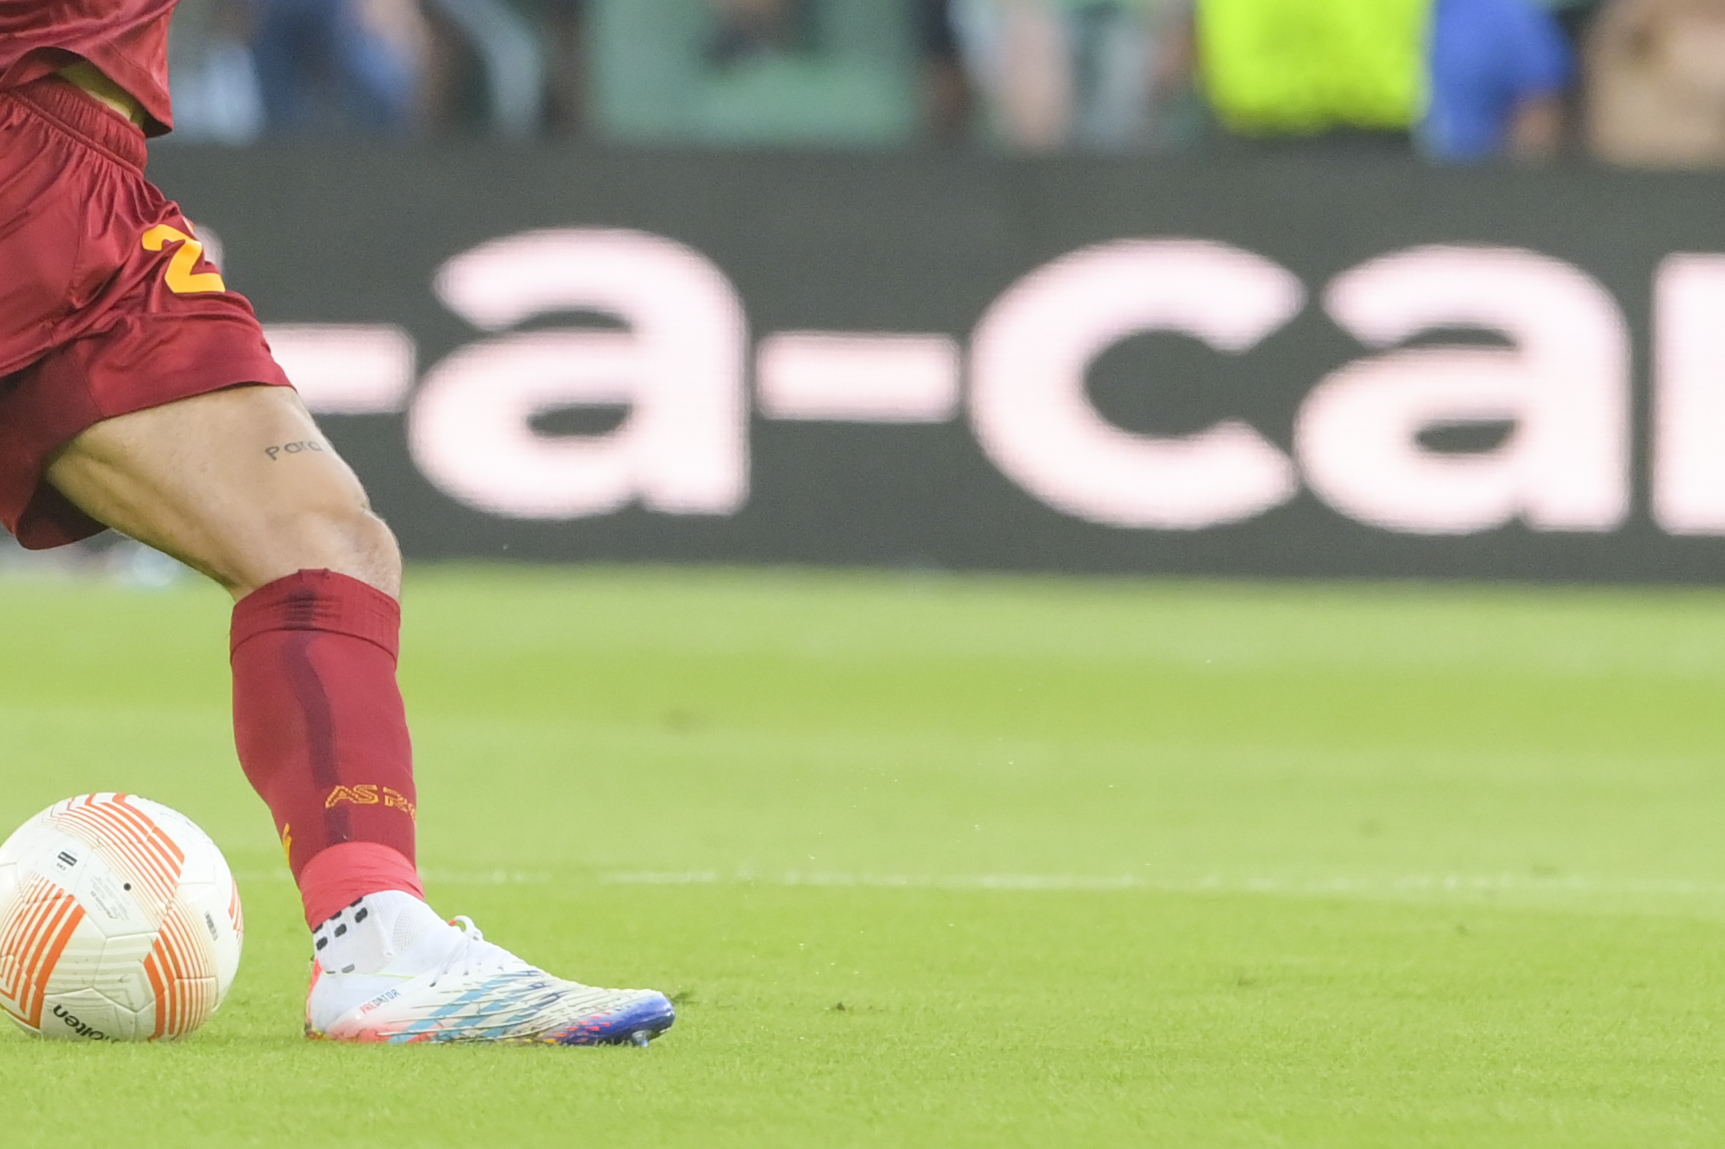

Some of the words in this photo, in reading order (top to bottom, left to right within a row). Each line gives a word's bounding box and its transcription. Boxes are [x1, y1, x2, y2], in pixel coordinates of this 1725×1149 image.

[142, 217, 225, 293] 2
[325, 784, 379, 809] AS
[53, 1004, 120, 1044] olten
